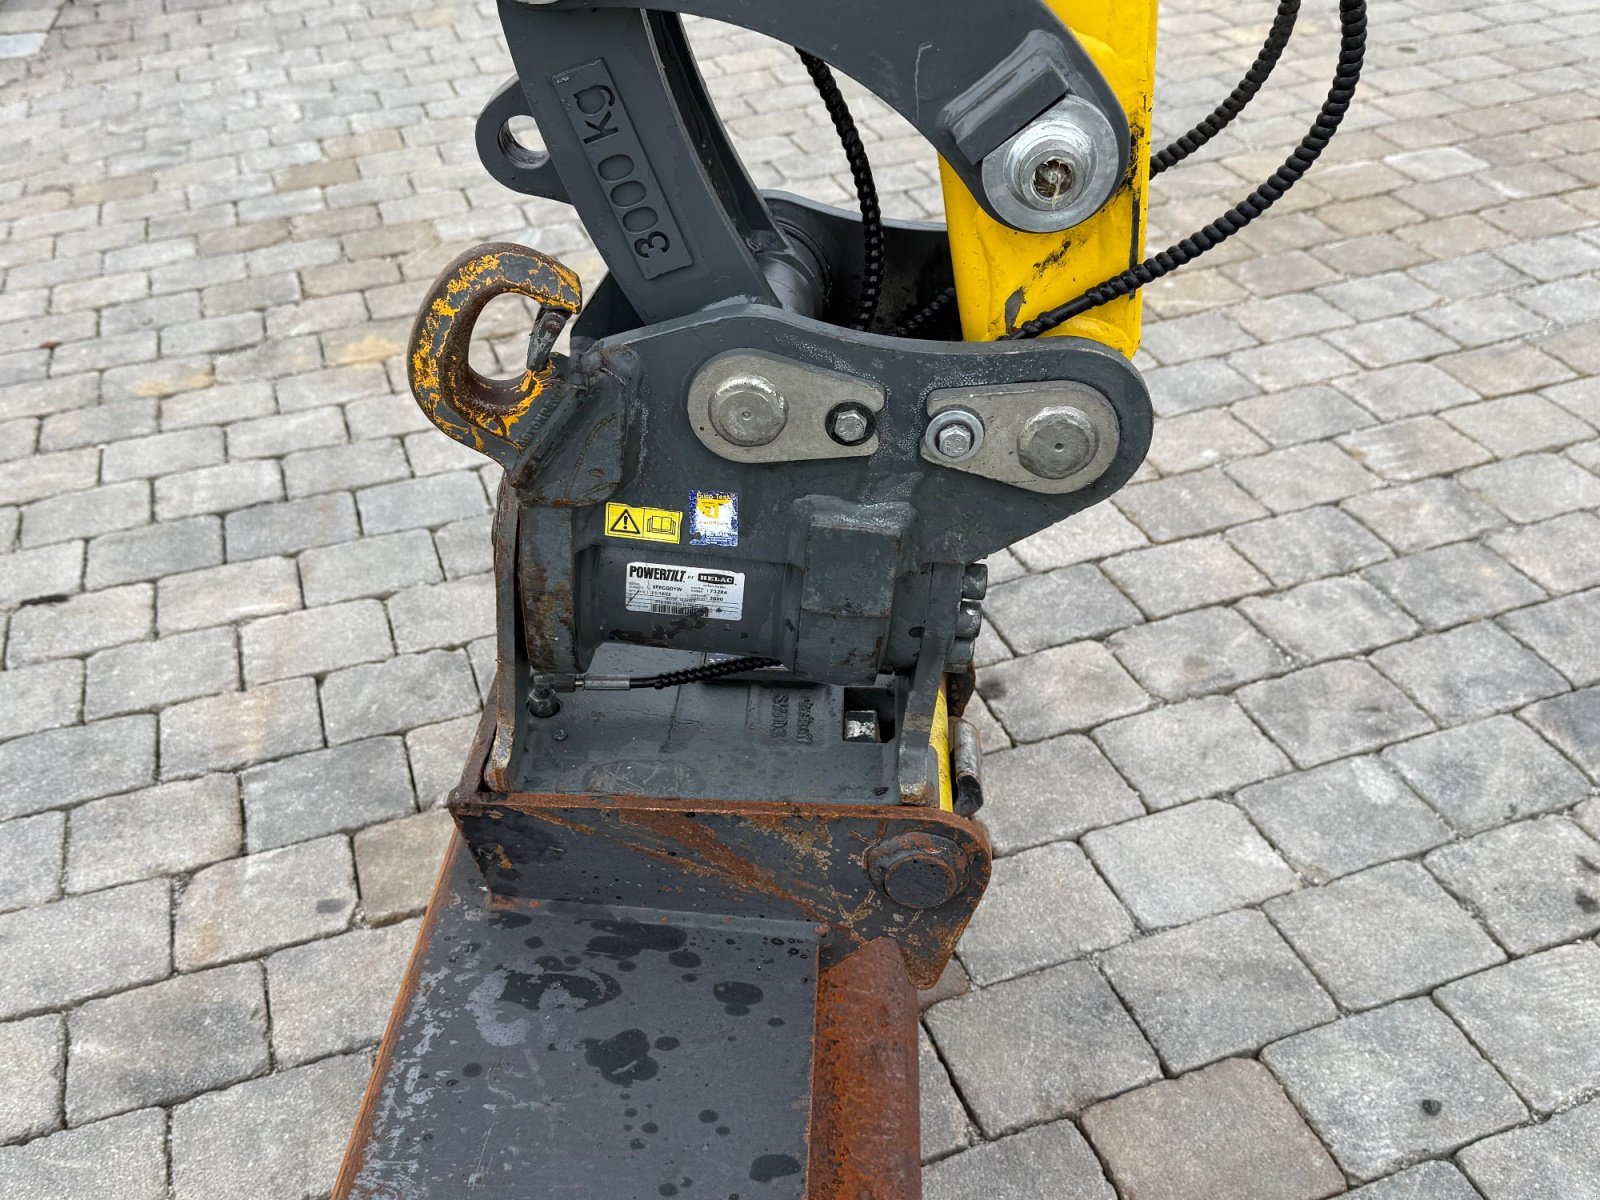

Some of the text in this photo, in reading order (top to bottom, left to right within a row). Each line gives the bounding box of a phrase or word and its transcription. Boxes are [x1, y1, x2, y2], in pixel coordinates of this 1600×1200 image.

[573, 84, 670, 259] 3000 kg
[629, 565, 686, 582] POWERTILT
[699, 575, 733, 583] HELAC
